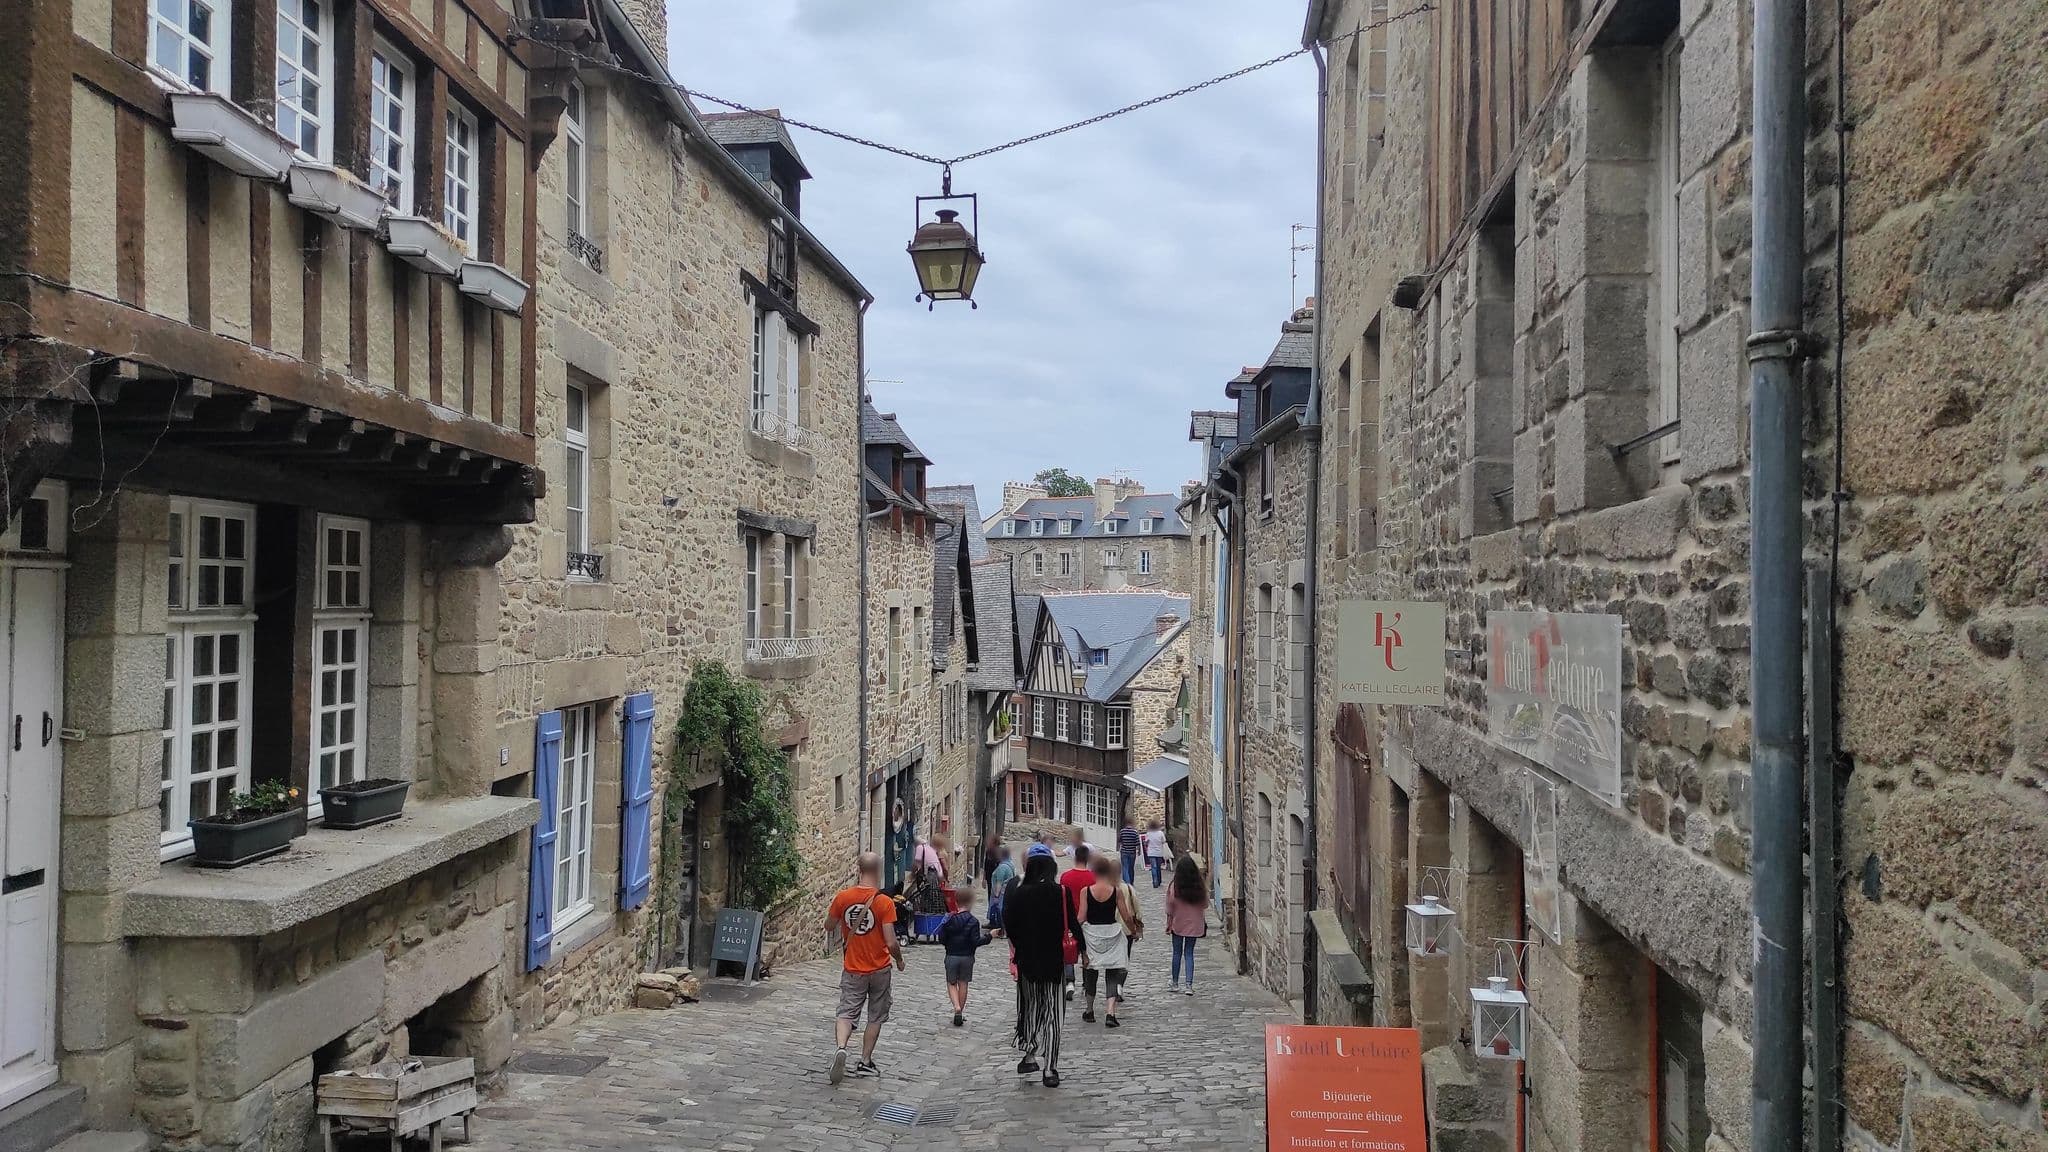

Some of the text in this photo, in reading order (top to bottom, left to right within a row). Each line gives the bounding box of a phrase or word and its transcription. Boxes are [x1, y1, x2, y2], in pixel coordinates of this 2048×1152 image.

[1341, 683, 1440, 695] KATELL LECLAIRE
[732, 916, 741, 924] LE
[722, 925, 748, 935] PETIT
[720, 936, 747, 945] SALON
[1275, 1035, 1411, 1058] Katell Leclaire
[1322, 1090, 1372, 1103] Bijouterie
[1290, 1110, 1403, 1123] contemporaine éthique
[1291, 1136, 1405, 1151] Initiation et formations
